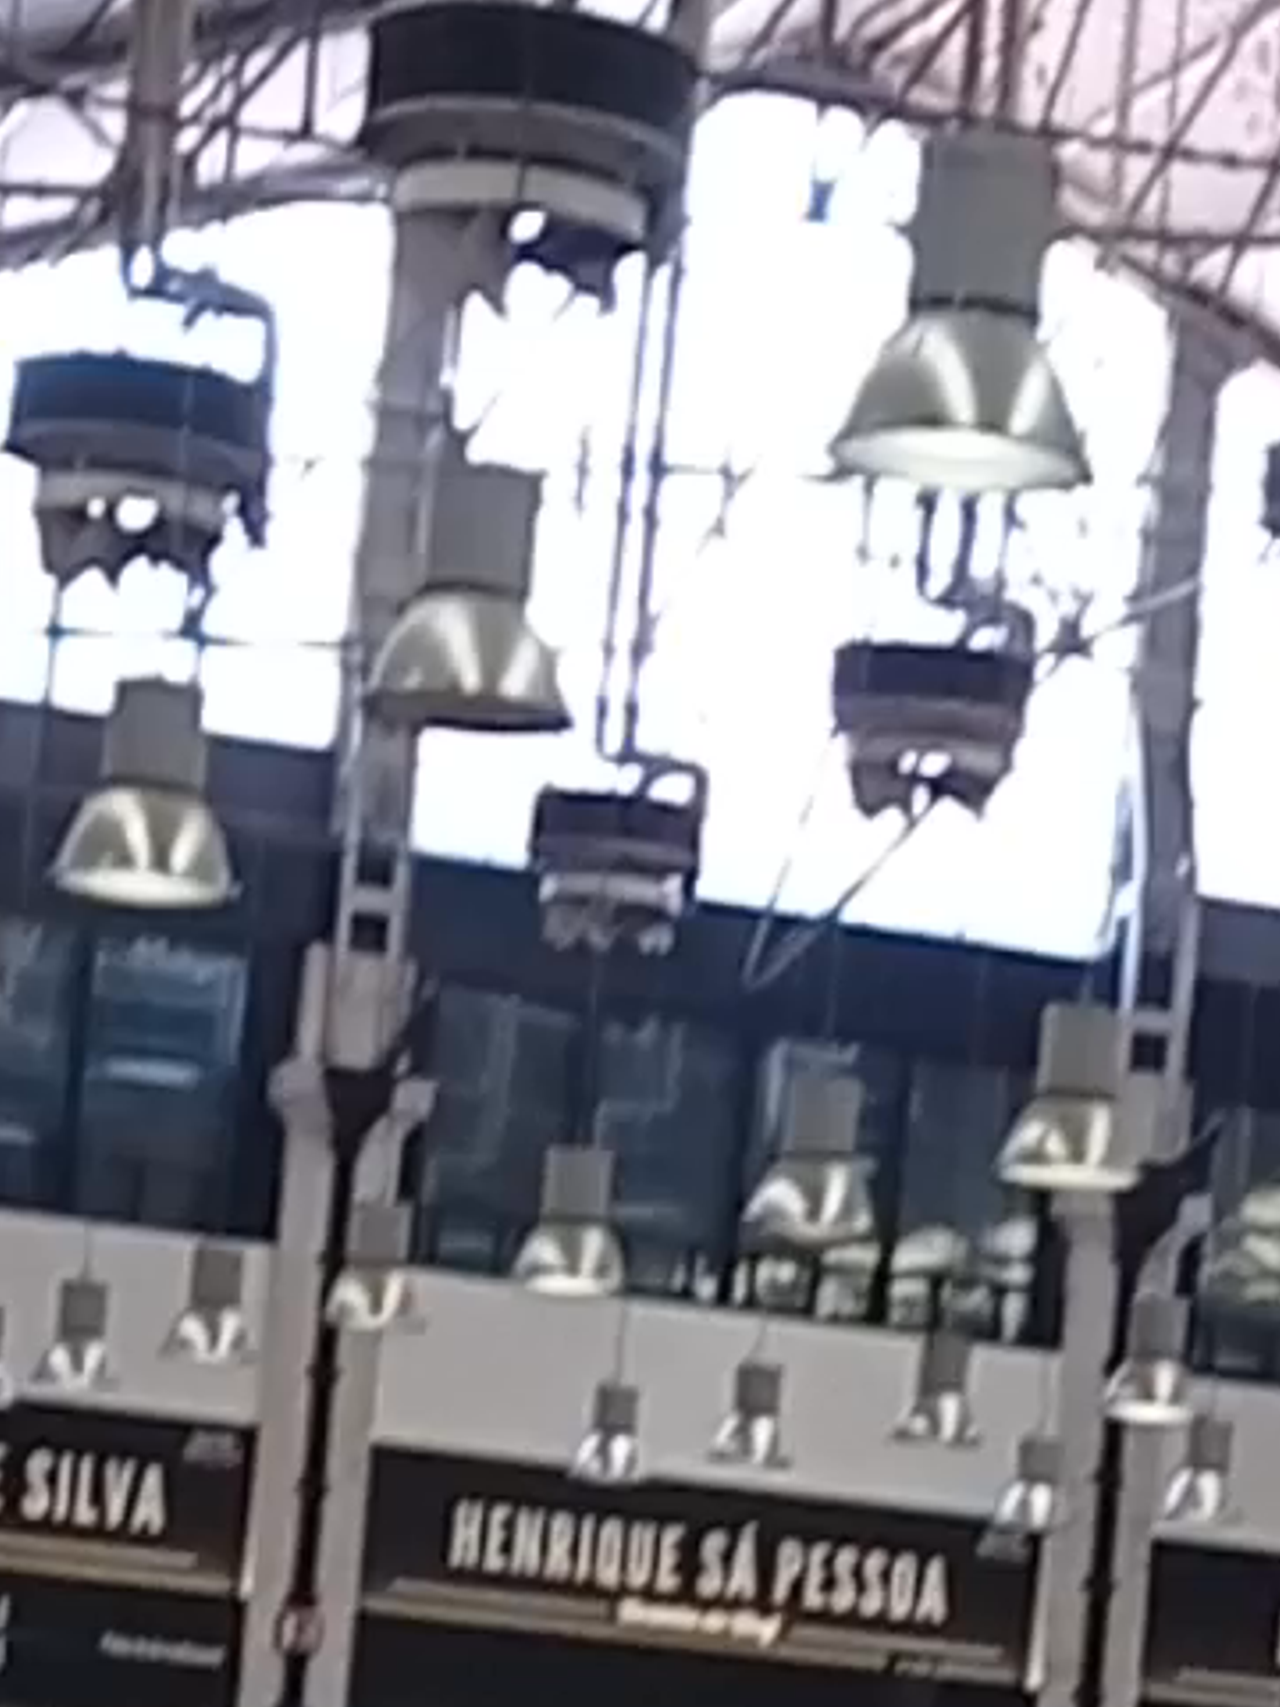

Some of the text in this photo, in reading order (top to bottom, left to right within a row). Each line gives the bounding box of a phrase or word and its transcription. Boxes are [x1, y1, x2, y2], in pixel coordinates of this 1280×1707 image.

[23, 1446, 167, 1537] SILVA
[447, 1498, 686, 1594] HENRIQUE
[695, 1520, 760, 1602] SÁ
[771, 1535, 949, 1626] PESSOA
